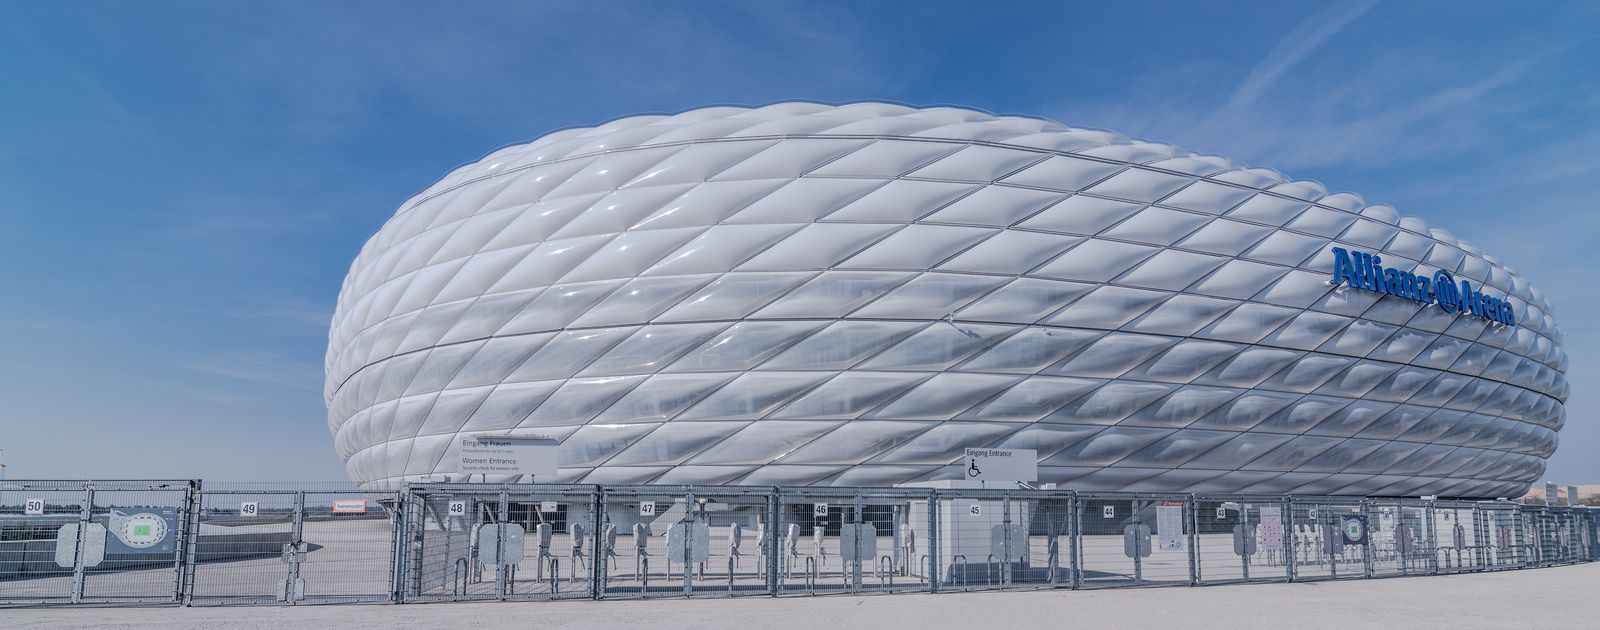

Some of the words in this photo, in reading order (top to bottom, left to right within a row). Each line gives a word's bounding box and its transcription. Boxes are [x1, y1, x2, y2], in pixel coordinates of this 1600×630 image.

[1331, 246, 1435, 304] Allianz
[1461, 279, 1516, 326] Arena
[966, 449, 988, 457] Eingang
[28, 501, 41, 511] 50
[242, 504, 255, 514] 49
[451, 503, 463, 513] 48
[642, 504, 653, 513] 47
[816, 504, 826, 513] 46
[970, 506, 980, 514] 45
[1105, 508, 1113, 516] 44
[1217, 509, 1225, 517] 43
